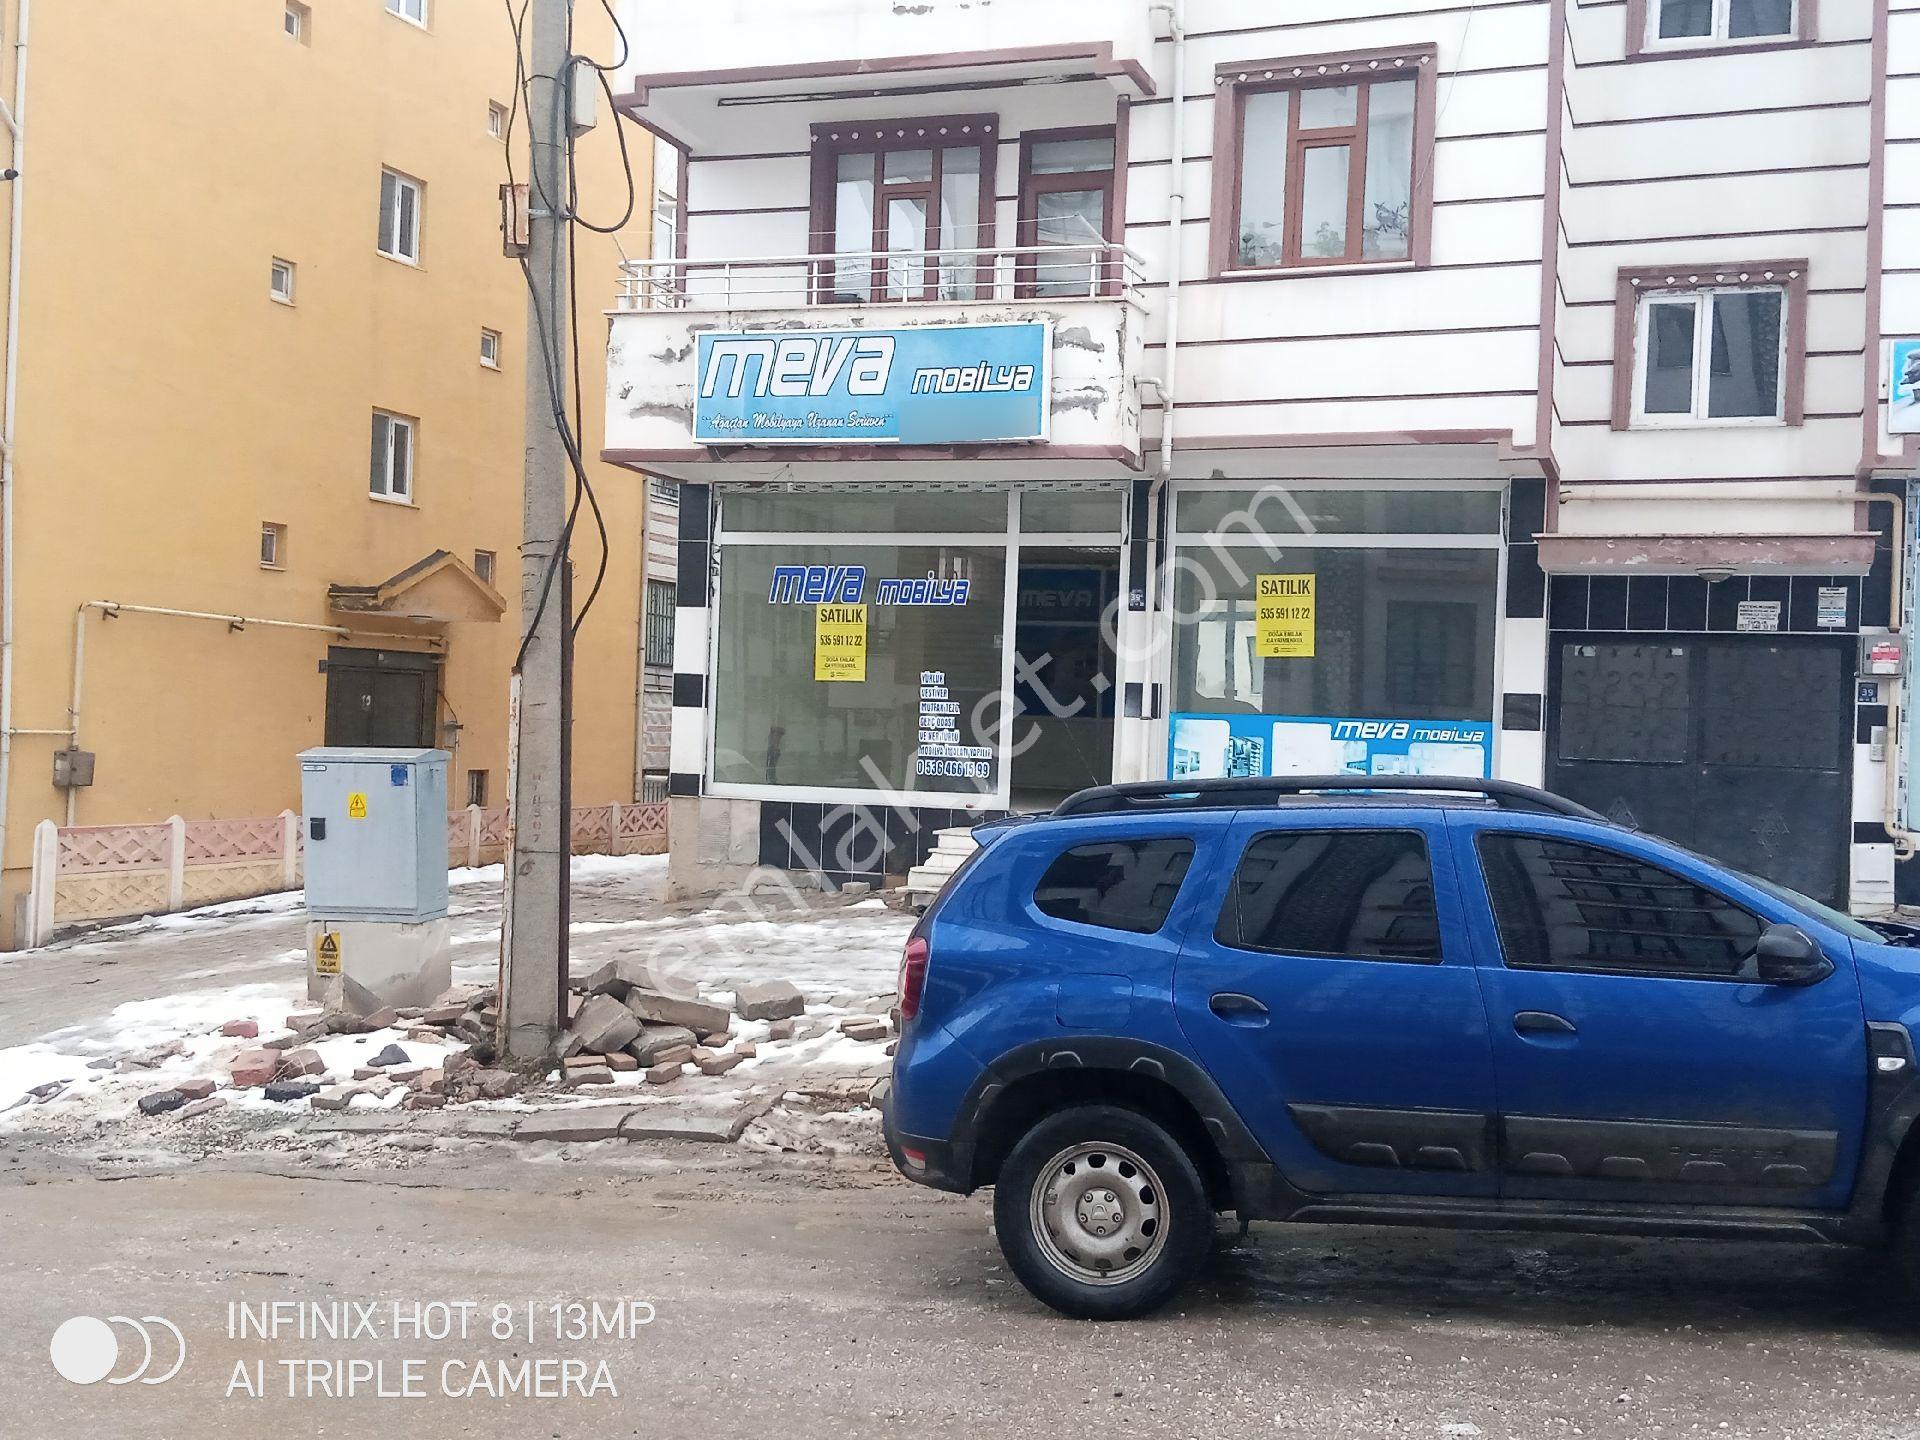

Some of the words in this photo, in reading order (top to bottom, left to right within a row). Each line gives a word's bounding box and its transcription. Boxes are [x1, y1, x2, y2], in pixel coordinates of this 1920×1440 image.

[752, 412, 804, 432] Mobilyaya
[808, 411, 845, 430] Uzanan
[1261, 580, 1310, 594] SATILIK
[820, 609, 863, 622] SATILIK
[1261, 608, 1274, 619] 535
[1276, 608, 1289, 619] 591
[1292, 608, 1299, 619] 12
[1301, 608, 1310, 619] 22
[820, 635, 831, 645] 535
[833, 635, 844, 646] 591
[846, 635, 853, 646] 12
[854, 635, 862, 646] 22
[1861, 688, 1874, 697] 39
[917, 760, 924, 775] 0
[925, 760, 943, 775] 536
[944, 761, 963, 776] 466
[964, 762, 975, 777] 15
[976, 762, 990, 777] 99
